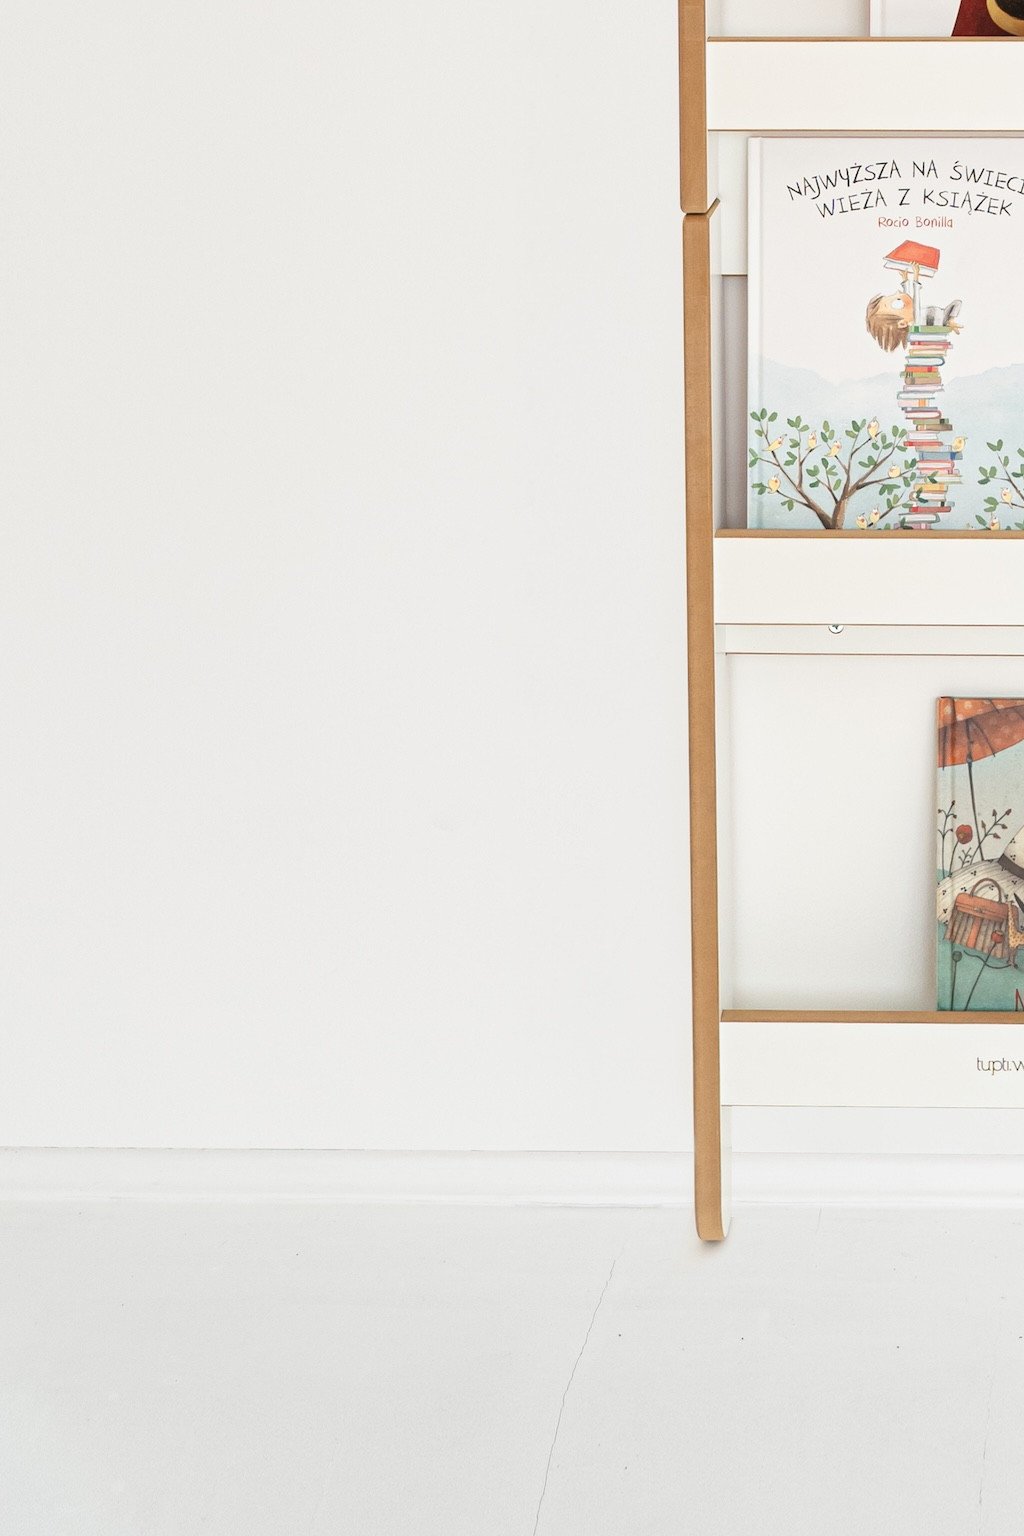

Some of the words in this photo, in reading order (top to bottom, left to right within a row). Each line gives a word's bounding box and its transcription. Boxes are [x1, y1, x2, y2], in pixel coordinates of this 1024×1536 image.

[786, 160, 901, 201] NAJWYŻSZA
[912, 160, 938, 179] NA
[815, 188, 887, 218] WIEŻA
[898, 188, 911, 206] Z
[923, 188, 1013, 217] KSIĄŻEK
[916, 216, 953, 228] Bonilla
